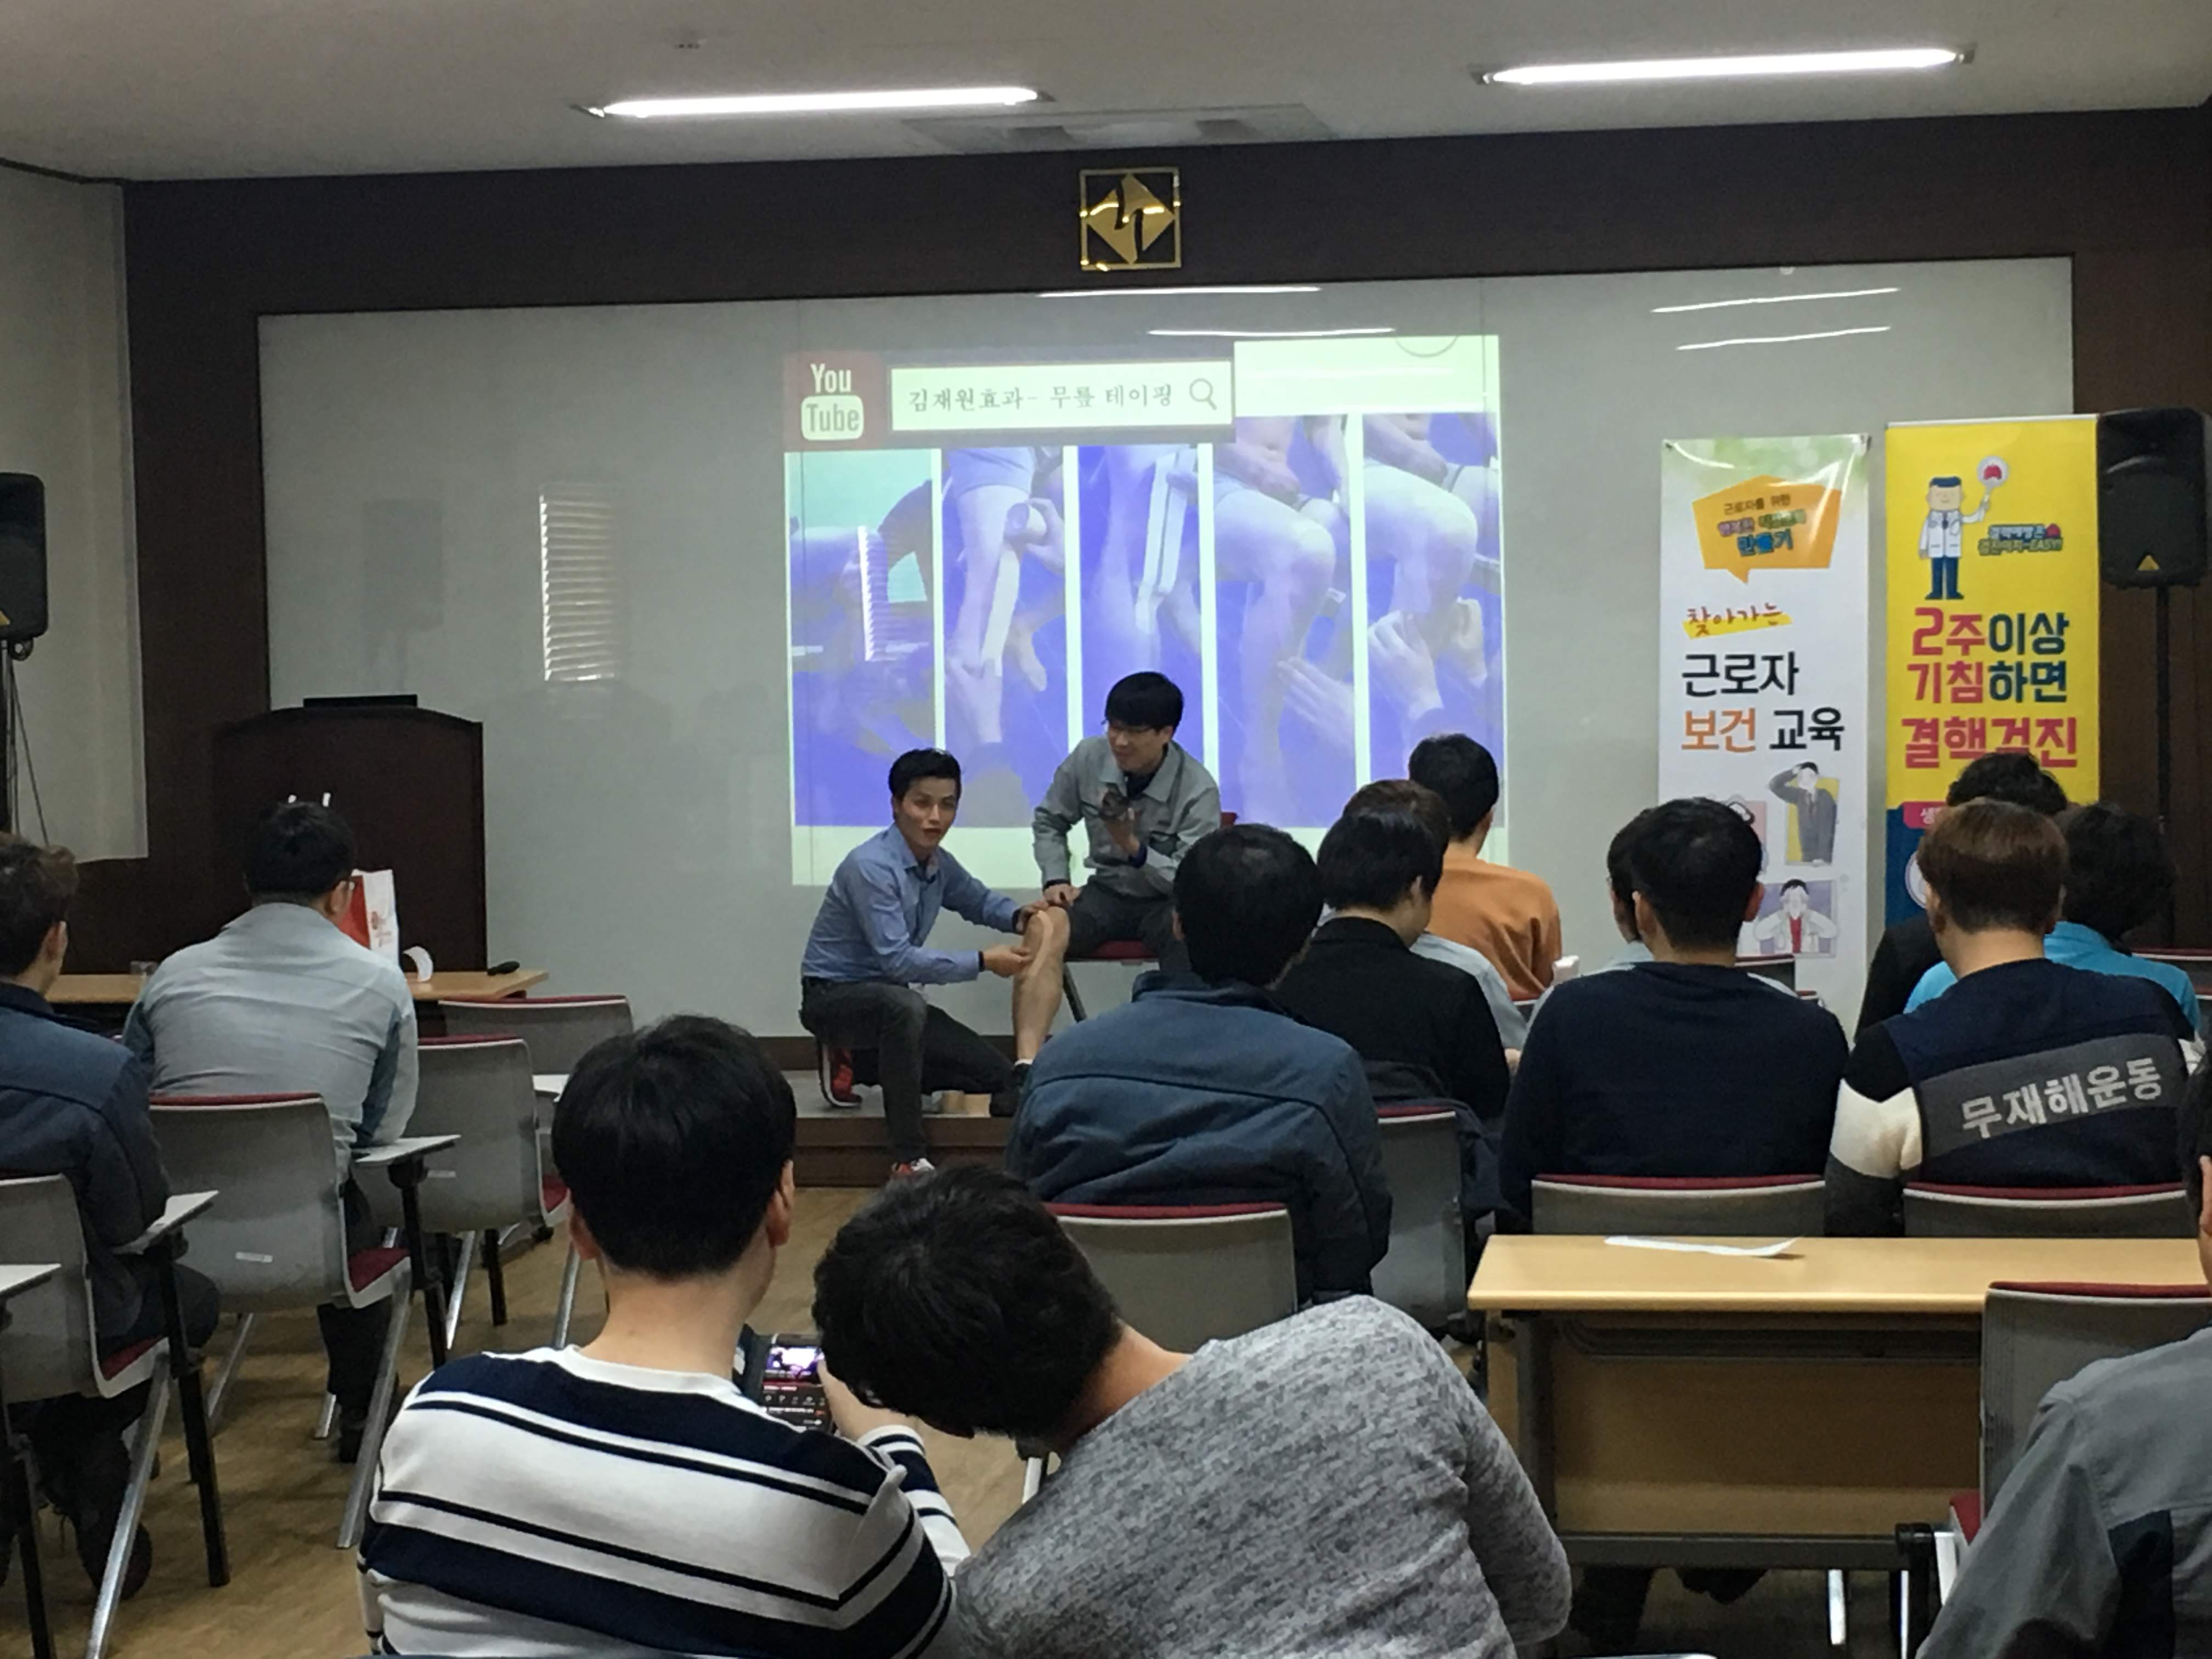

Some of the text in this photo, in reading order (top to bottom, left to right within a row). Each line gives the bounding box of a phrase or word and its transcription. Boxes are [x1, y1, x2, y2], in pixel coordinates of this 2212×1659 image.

[810, 363, 851, 393] You
[1050, 386, 1095, 409] 무릎
[1105, 383, 1171, 407] 테이핑
[806, 403, 859, 432] Tube
[1737, 528, 1793, 557] 만들기
[1686, 602, 1783, 637] 찾아가는
[1681, 651, 1799, 697] 근로자
[1907, 660, 2067, 703] 기침하면
[1681, 707, 1844, 753] 보건 교육
[1962, 1057, 2162, 1139] 무재해운동
